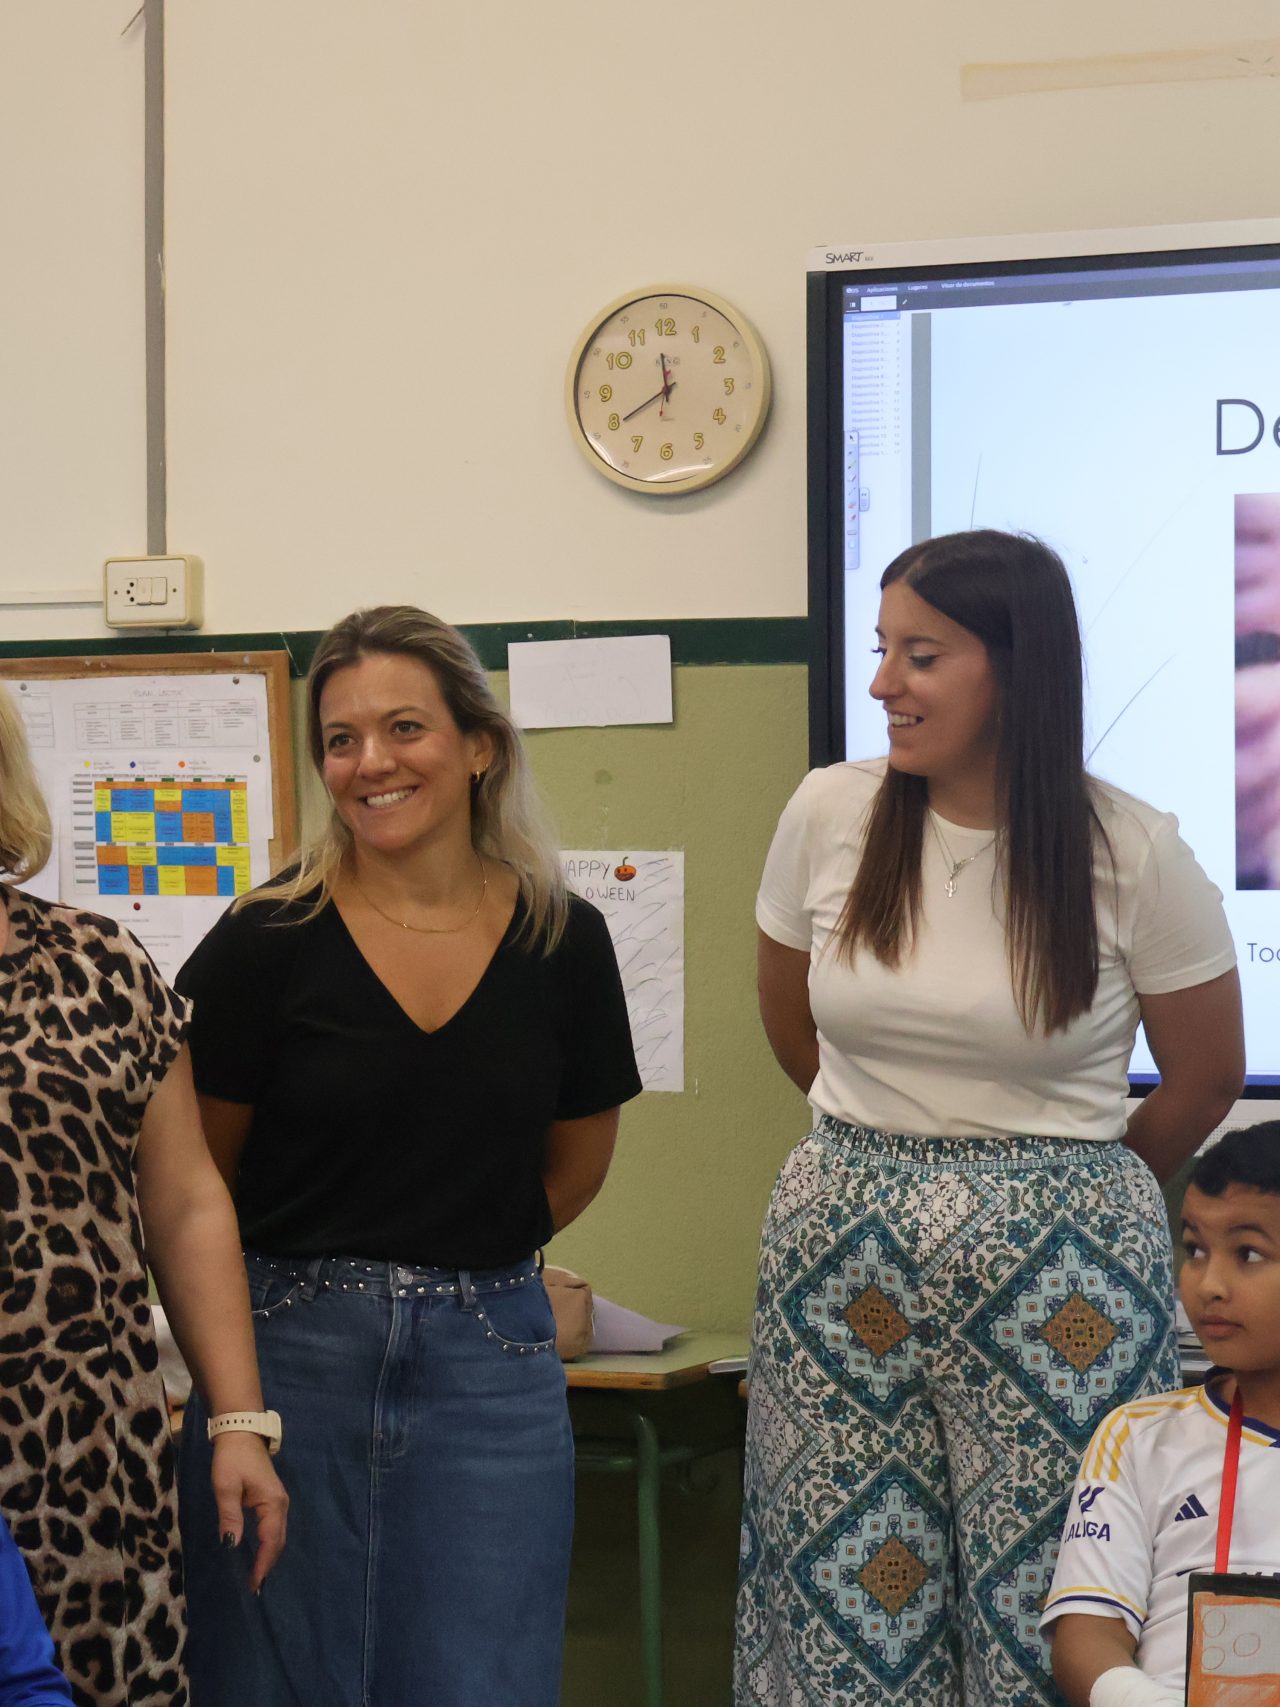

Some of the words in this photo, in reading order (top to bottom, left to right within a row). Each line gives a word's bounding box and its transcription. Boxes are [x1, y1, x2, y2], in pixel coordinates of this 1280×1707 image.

[825, 252, 864, 264] SMART
[866, 286, 898, 294] Aplicaciones
[963, 279, 995, 288] documentos
[655, 318, 676, 336] 12
[691, 326, 700, 343] 1
[628, 329, 646, 346] 11
[606, 351, 632, 370] 10
[713, 346, 726, 364] 2
[599, 384, 613, 403] 9
[723, 378, 734, 395] 3
[608, 413, 620, 431] 8
[712, 408, 727, 425] 4
[1216, 398, 1280, 456] D
[631, 435, 644, 453] 7
[693, 432, 704, 450] 5
[660, 442, 673, 460] 6
[1247, 942, 1280, 963] To
